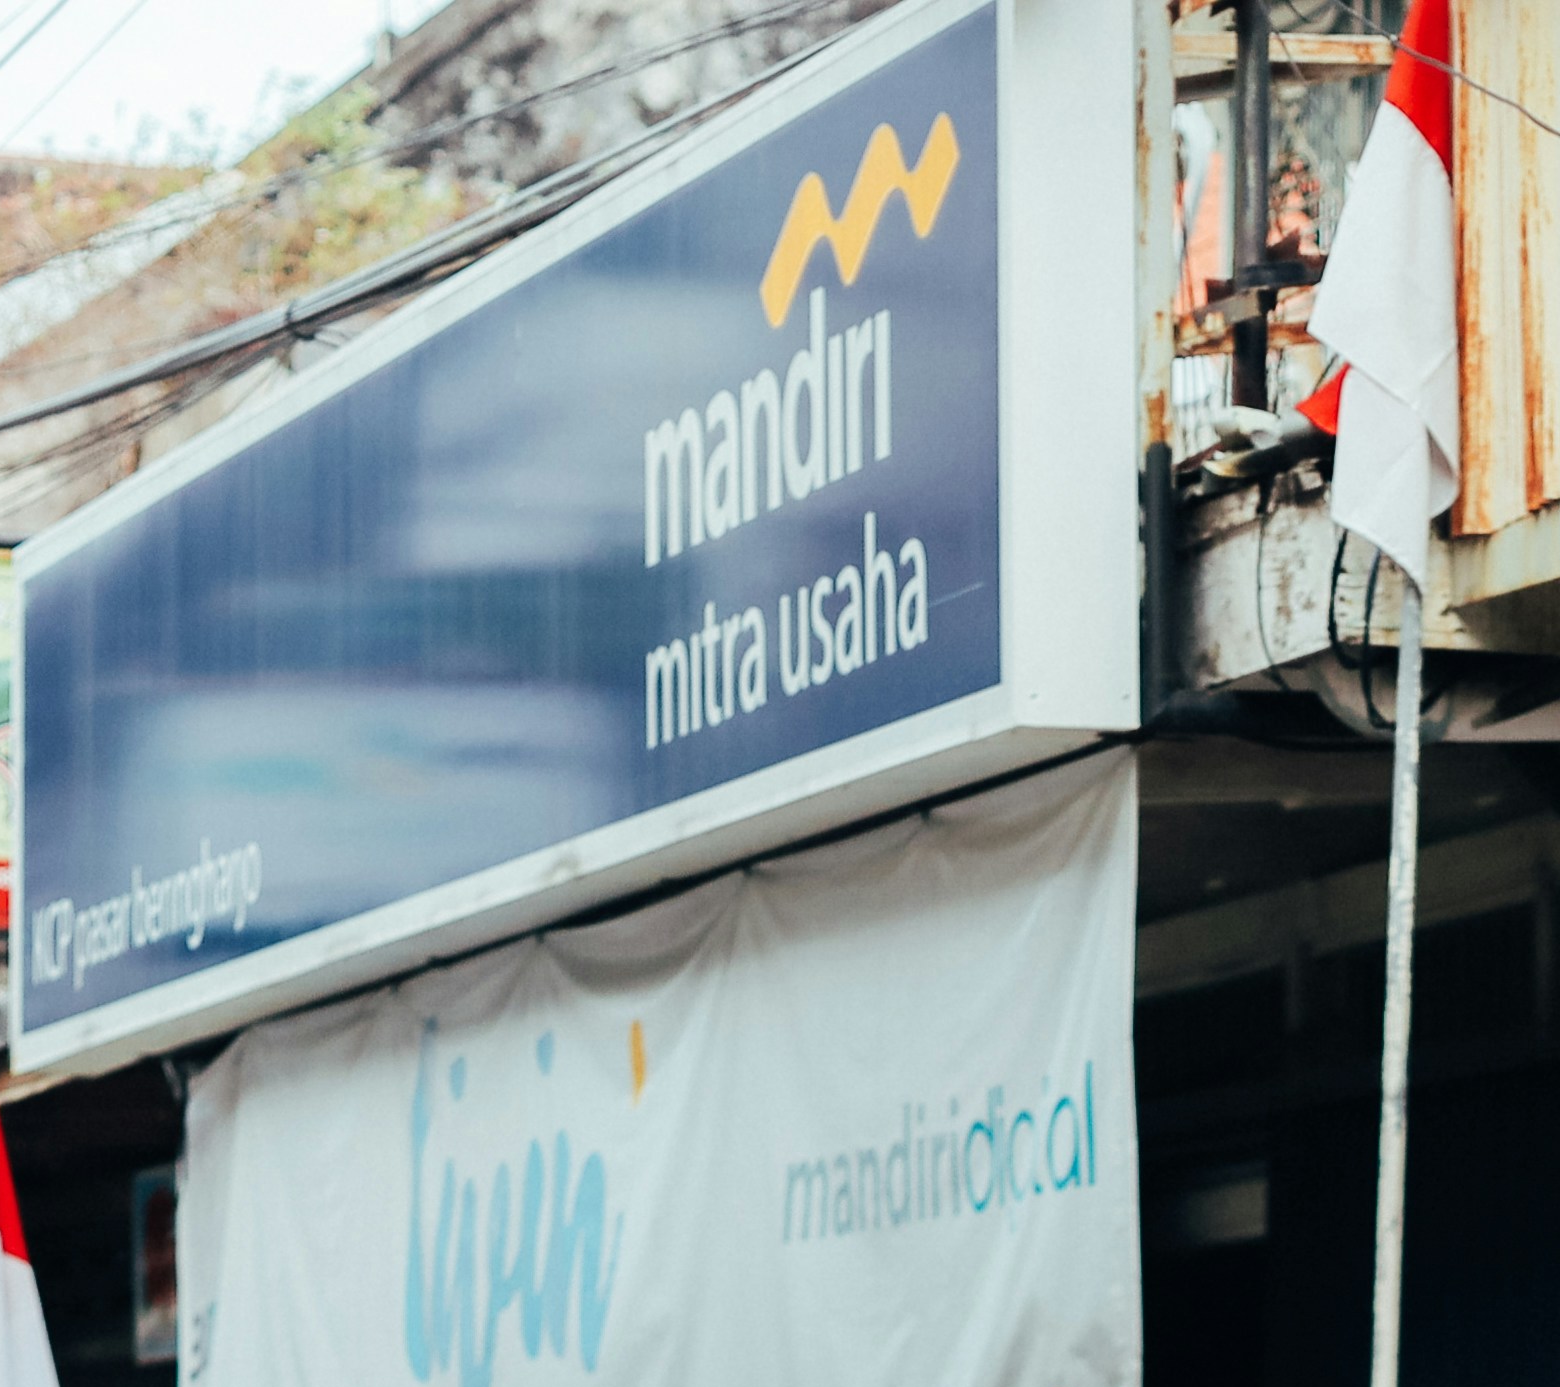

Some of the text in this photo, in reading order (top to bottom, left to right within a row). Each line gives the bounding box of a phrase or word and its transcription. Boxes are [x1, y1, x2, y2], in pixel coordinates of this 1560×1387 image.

[644, 286, 892, 569] mandiri
[645, 510, 929, 750] mitra usaha
